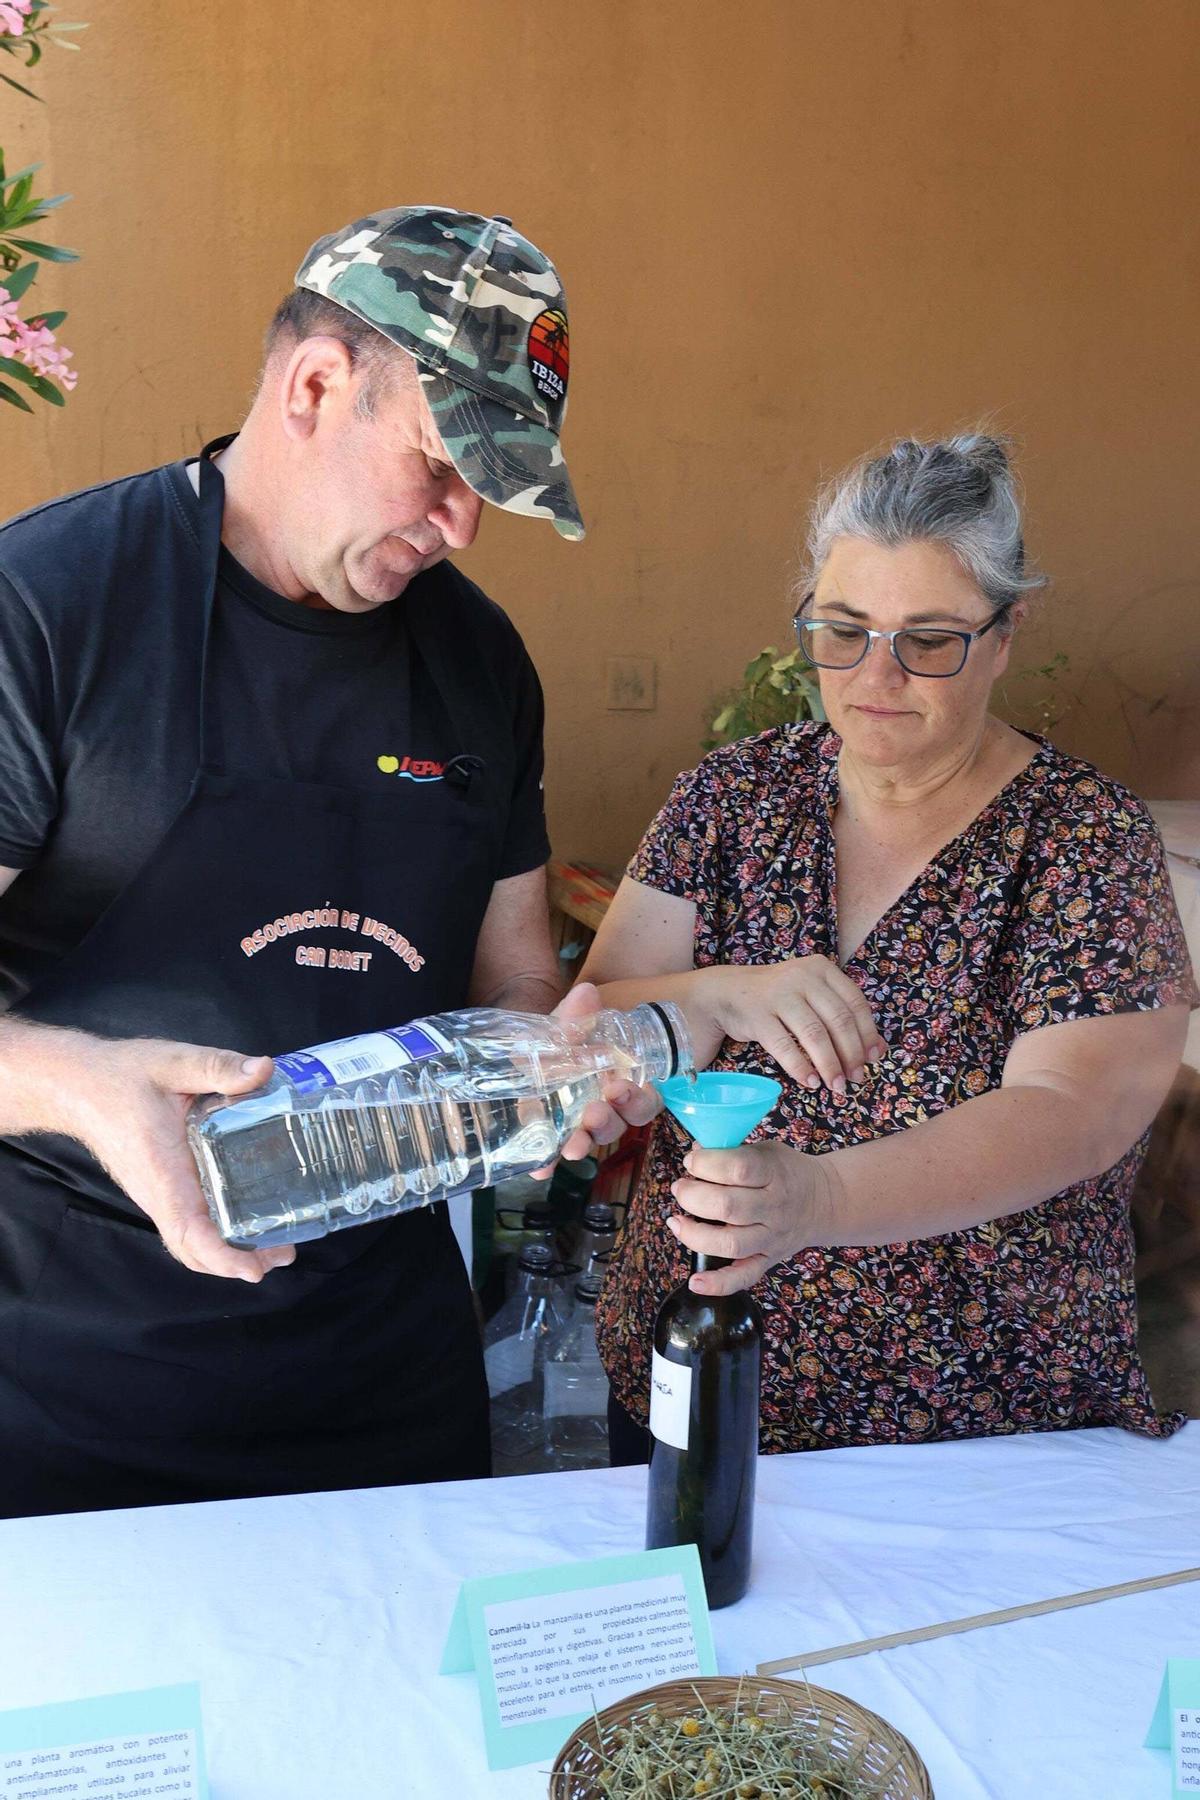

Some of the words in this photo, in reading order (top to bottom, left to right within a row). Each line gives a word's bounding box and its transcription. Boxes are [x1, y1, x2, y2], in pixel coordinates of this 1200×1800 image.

[531, 360, 564, 394] IBIZA
[537, 380, 559, 401] BEACH
[240, 900, 339, 958] ASOCIACIÓN
[340, 910, 360, 932] DE
[361, 916, 426, 973] VECINOS
[295, 945, 326, 967] CAN
[532, 1621, 541, 1629] La
[543, 1612, 583, 1625] manzanilla
[594, 1608, 608, 1616] una
[609, 1604, 632, 1614] planta
[633, 1596, 668, 1608] medicinal
[670, 1594, 687, 1603] muy
[491, 1638, 527, 1651] apreciada
[543, 1632, 557, 1641] por
[602, 1616, 648, 1629] propiedades
[493, 1647, 555, 1664] antiinflamatorias
[608, 1631, 635, 1642] Gracias
[646, 1621, 691, 1635] compuestos
[495, 1670, 516, 1679] como
[521, 1665, 529, 1673] la
[577, 1653, 599, 1662] relaja
[604, 1649, 611, 1657] el
[616, 1644, 645, 1655] sistema
[650, 1637, 684, 1648] nervioso
[545, 1675, 560, 1684] que
[562, 1672, 570, 1680] la
[572, 1665, 607, 1678] convierte
[609, 1663, 619, 1671] en
[635, 1654, 667, 1665] remedio
[668, 1647, 696, 1659] natural
[500, 1695, 534, 1707] excelente
[538, 1691, 555, 1700] para
[558, 1687, 566, 1695] el
[608, 1673, 643, 1685] insomnio
[655, 1668, 666, 1676] los
[670, 1662, 699, 1673] dolores
[1181, 1714, 1188, 1722] El
[4, 1760, 22, 1768] una
[31, 1754, 60, 1765] planta
[69, 1744, 114, 1758] aromática
[123, 1741, 140, 1749] con
[148, 1733, 188, 1746] potentes
[105, 1752, 166, 1769] antioxidantes
[17, 1783, 79, 1800] ampliamente
[87, 1775, 125, 1788] utilizada
[134, 1771, 154, 1781] para
[163, 1764, 190, 1775] aliviar
[117, 1787, 152, 1799] bucales
[155, 1783, 180, 1793] como
[183, 1780, 191, 1788] la
